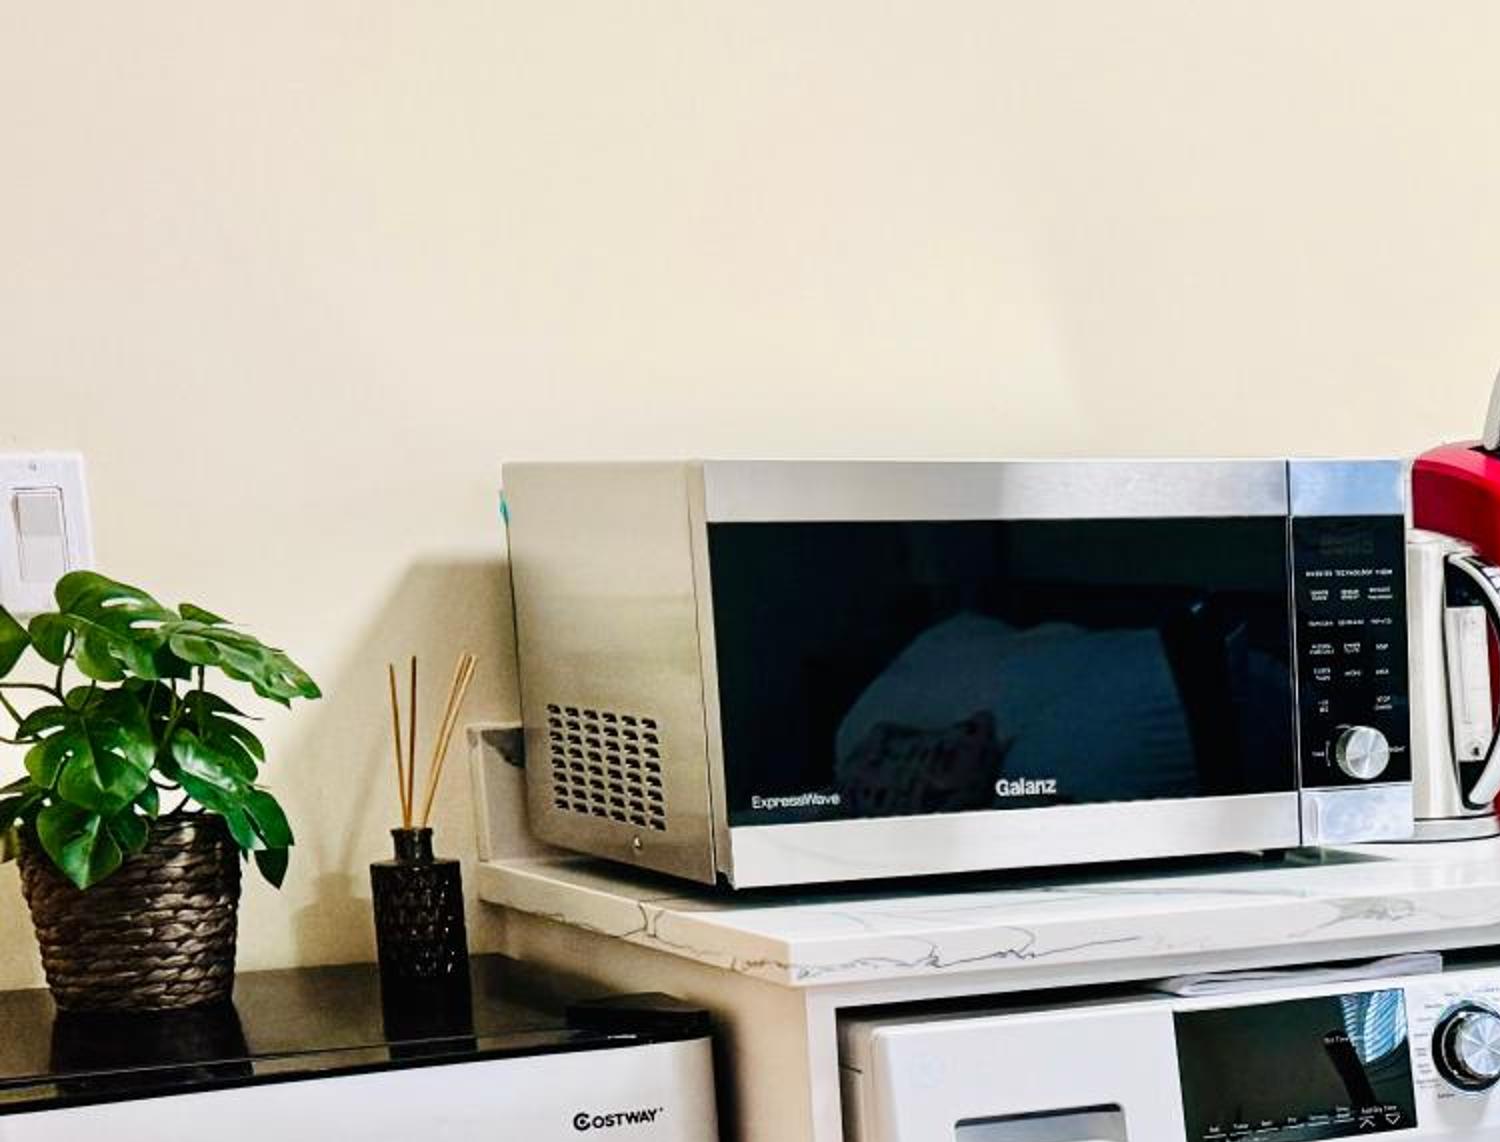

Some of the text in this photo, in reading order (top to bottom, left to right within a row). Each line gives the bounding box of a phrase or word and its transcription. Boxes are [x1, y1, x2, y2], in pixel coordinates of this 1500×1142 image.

[995, 777, 1057, 797] Galanz
[751, 792, 841, 810] ExpressWave
[573, 1107, 657, 1131] COSTWAY
